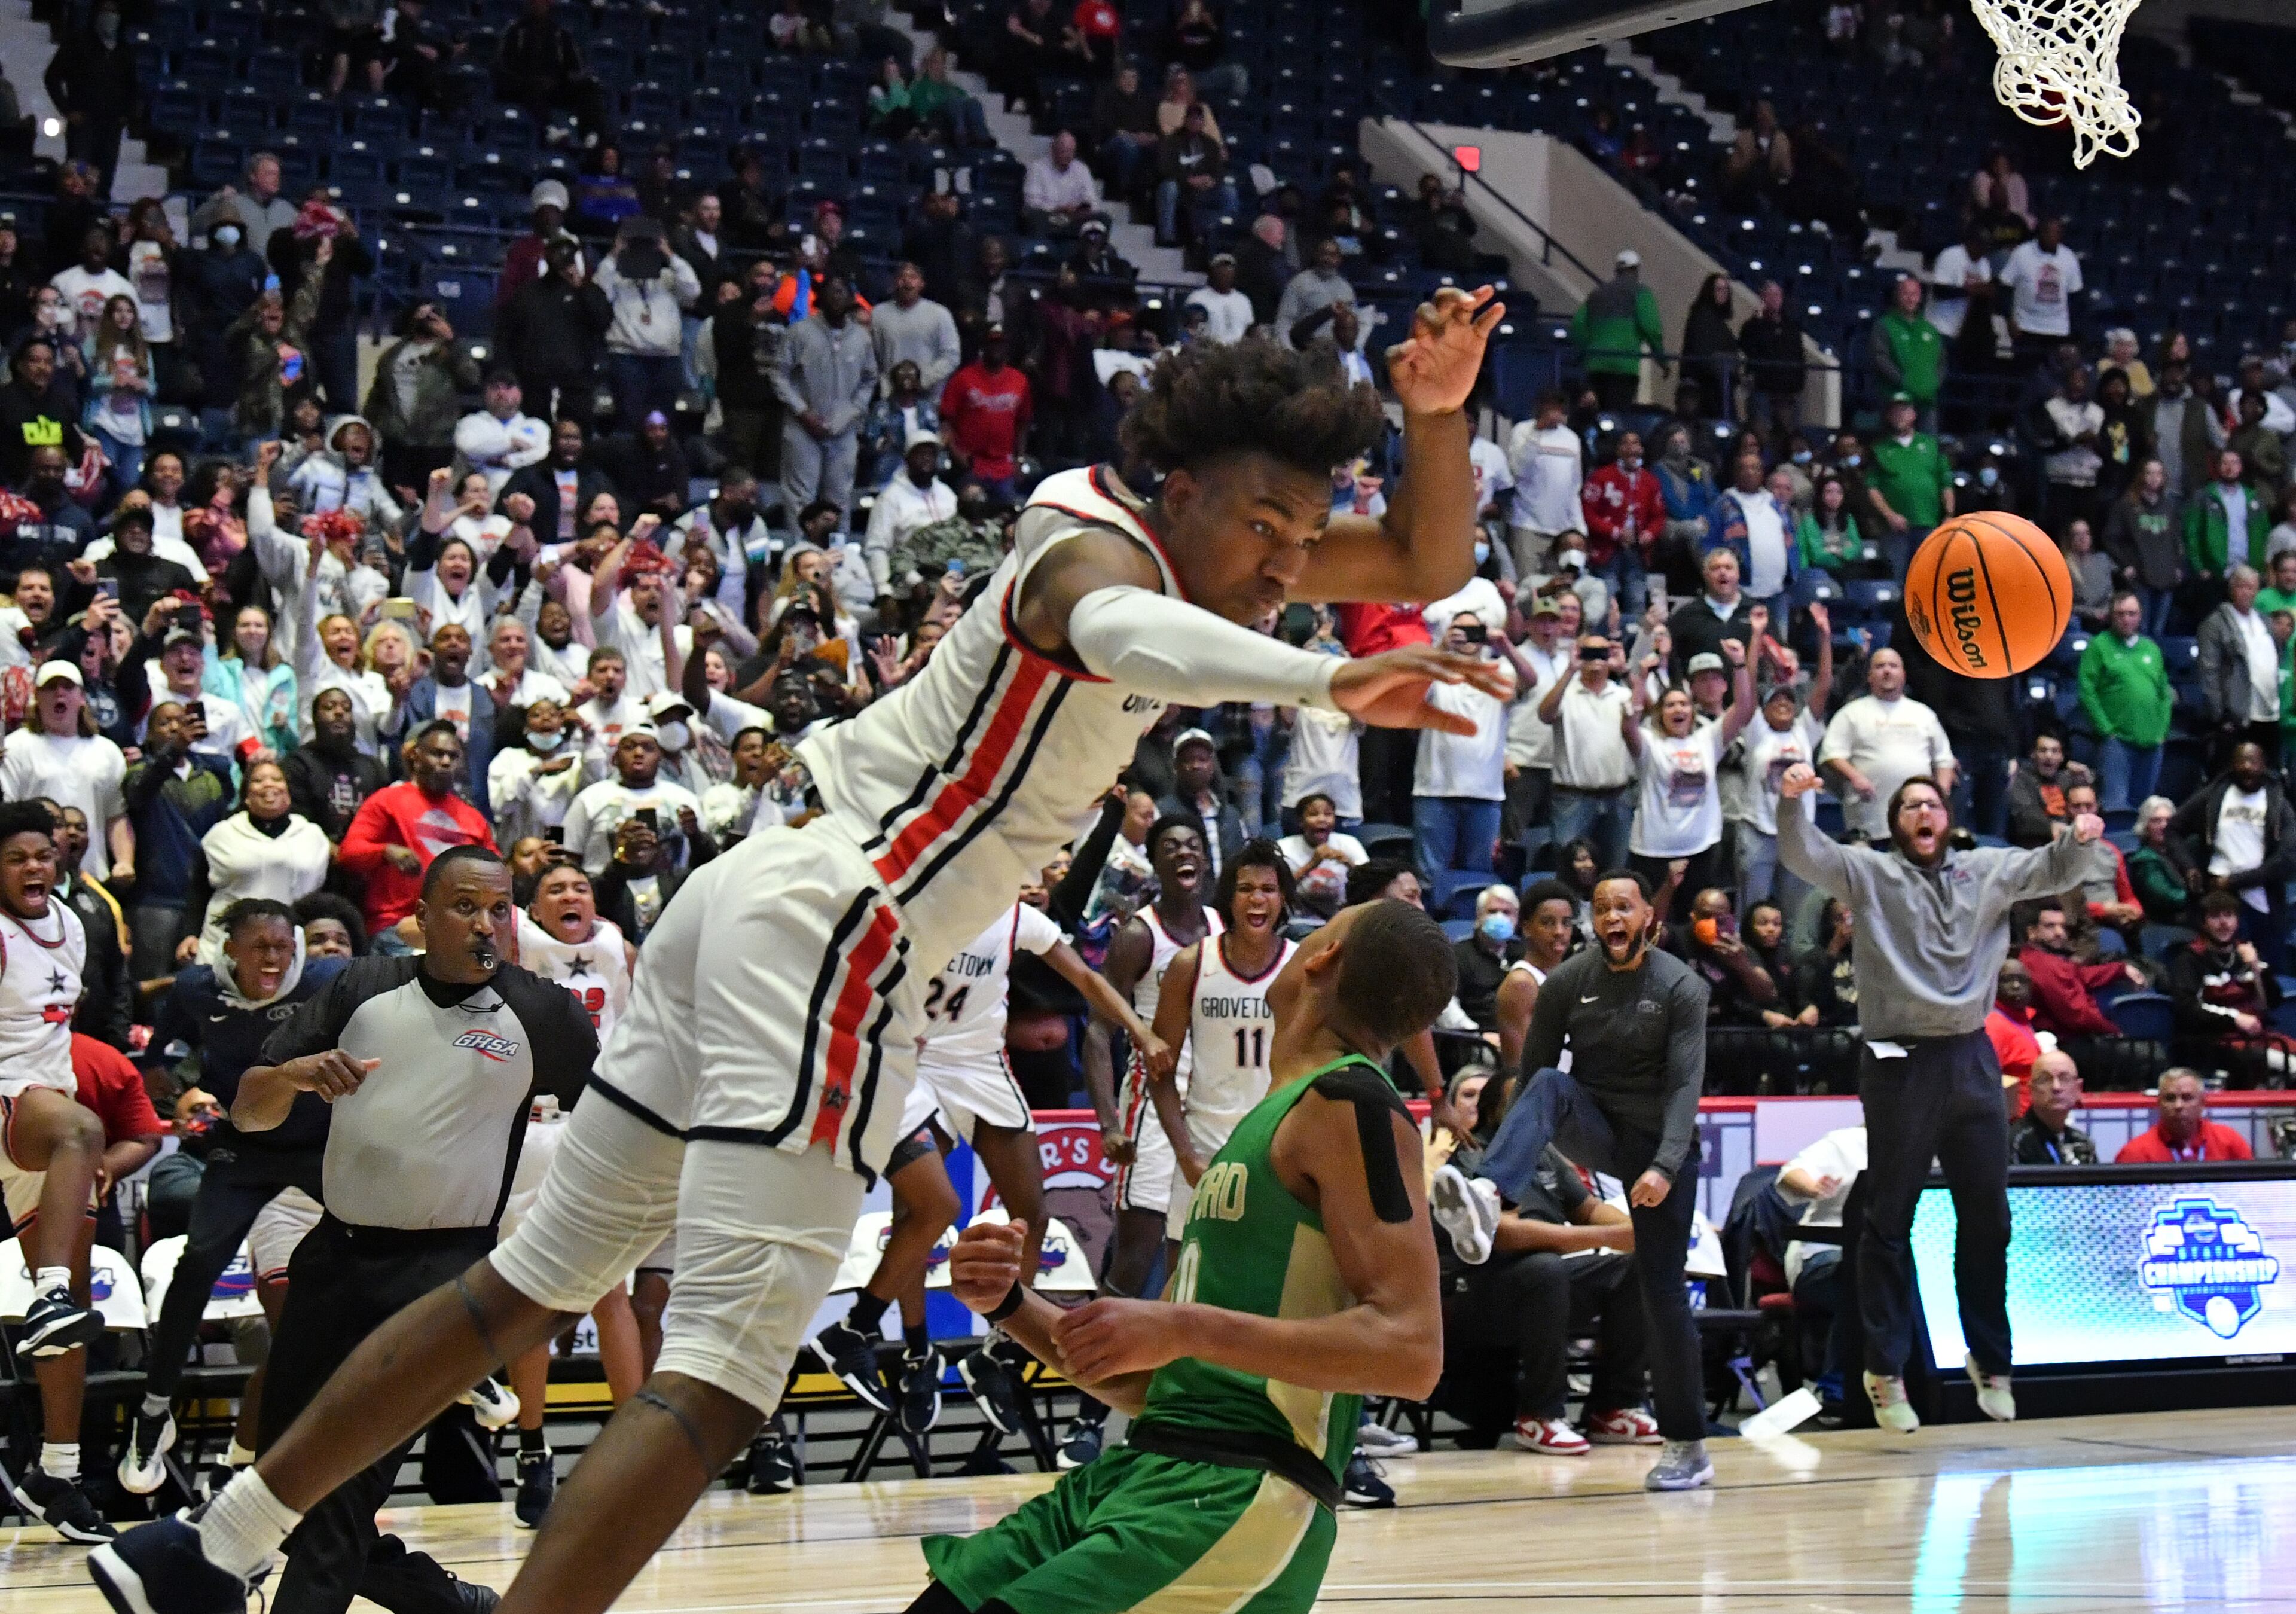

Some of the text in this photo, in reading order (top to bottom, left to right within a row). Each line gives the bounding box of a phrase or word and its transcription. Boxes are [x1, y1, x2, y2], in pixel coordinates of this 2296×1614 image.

[1947, 567, 1988, 669] Wilson
[923, 976, 971, 1022] 24
[453, 1034, 520, 1056] GHSA
[1234, 1026, 1265, 1069] 11
